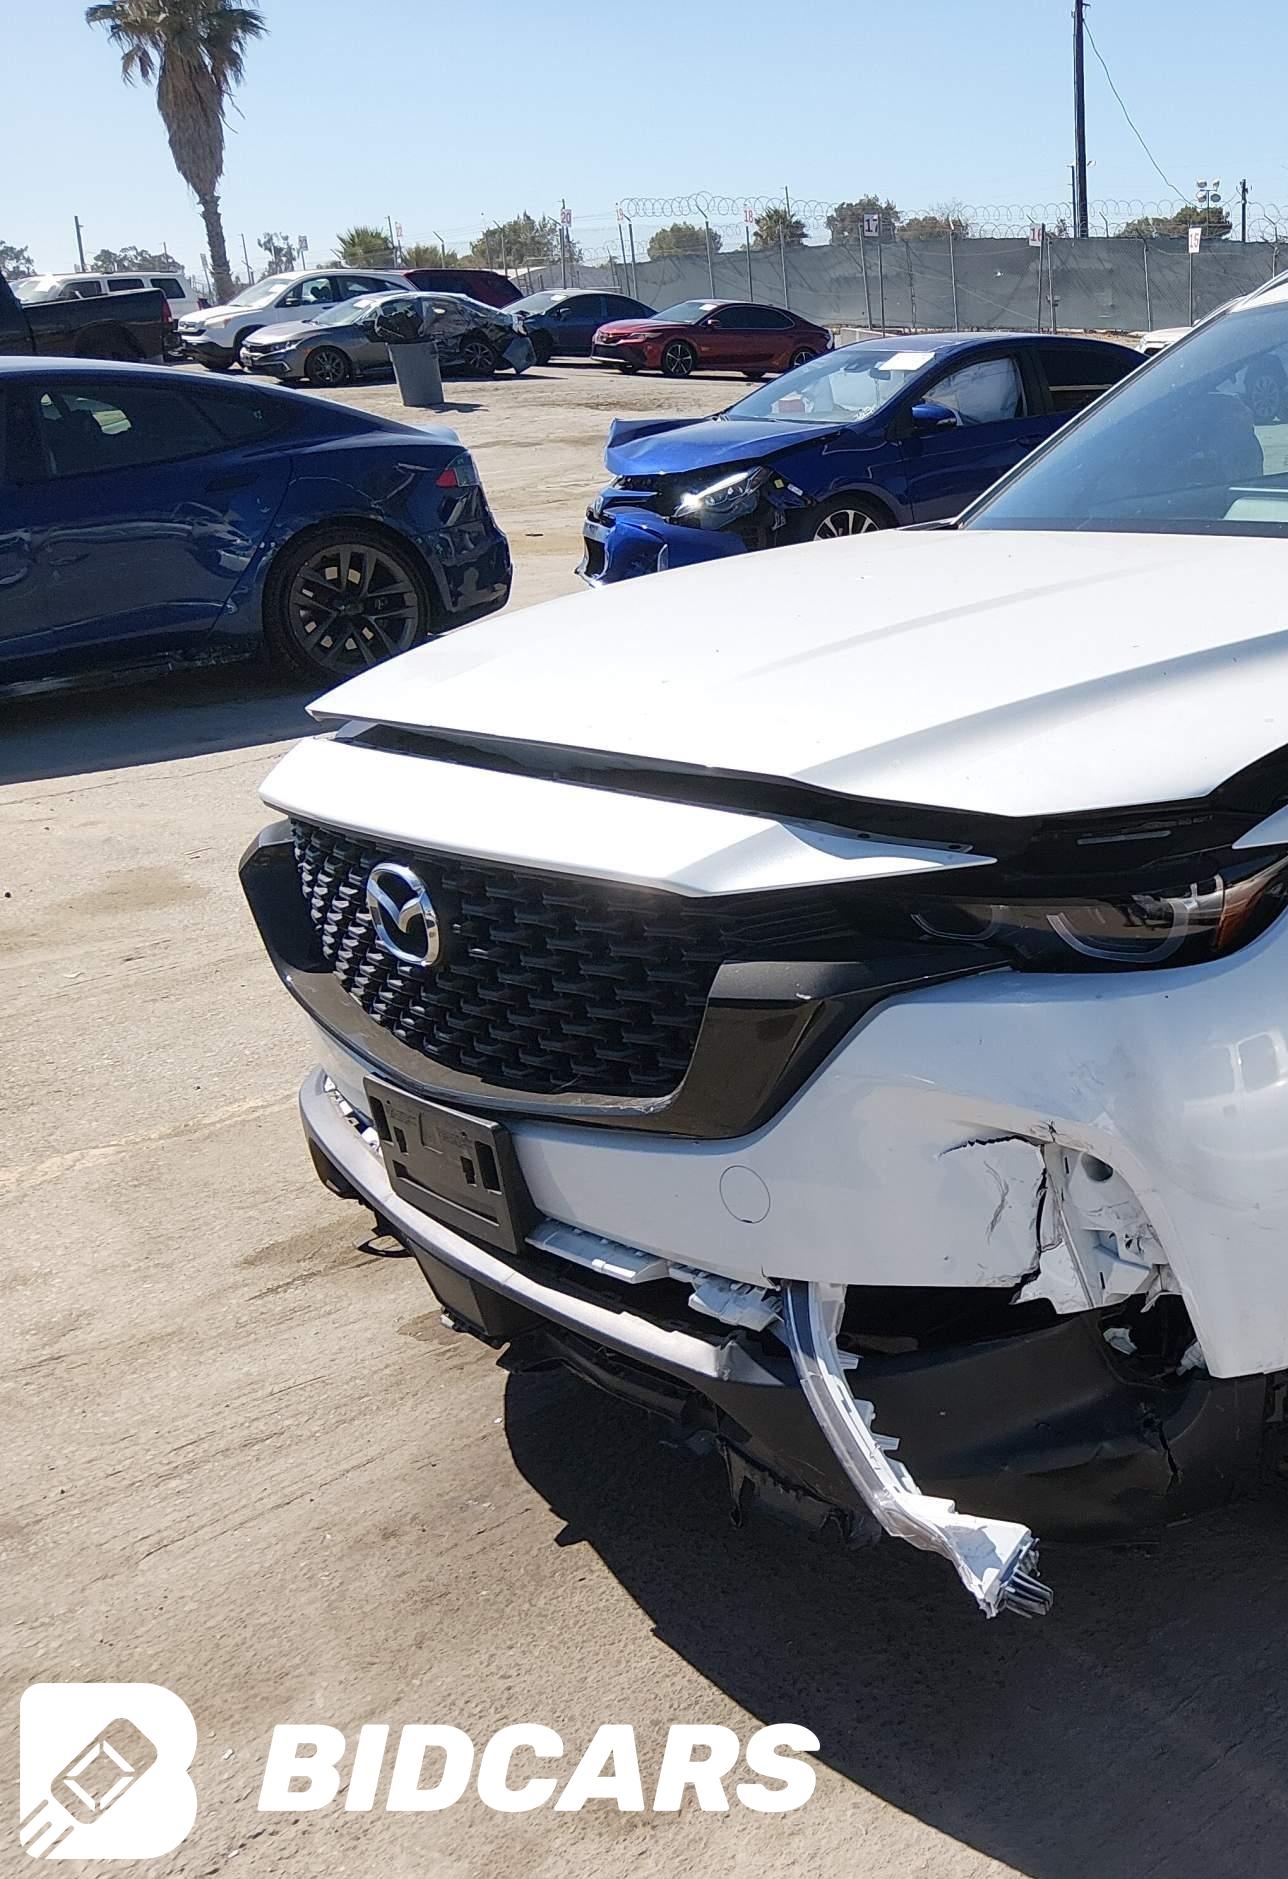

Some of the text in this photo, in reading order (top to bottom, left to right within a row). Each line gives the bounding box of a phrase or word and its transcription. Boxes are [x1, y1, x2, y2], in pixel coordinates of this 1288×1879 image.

[560, 211, 571, 224] 20
[743, 209, 754, 223] 18
[865, 218, 879, 233] 17
[1189, 233, 1200, 248] 15
